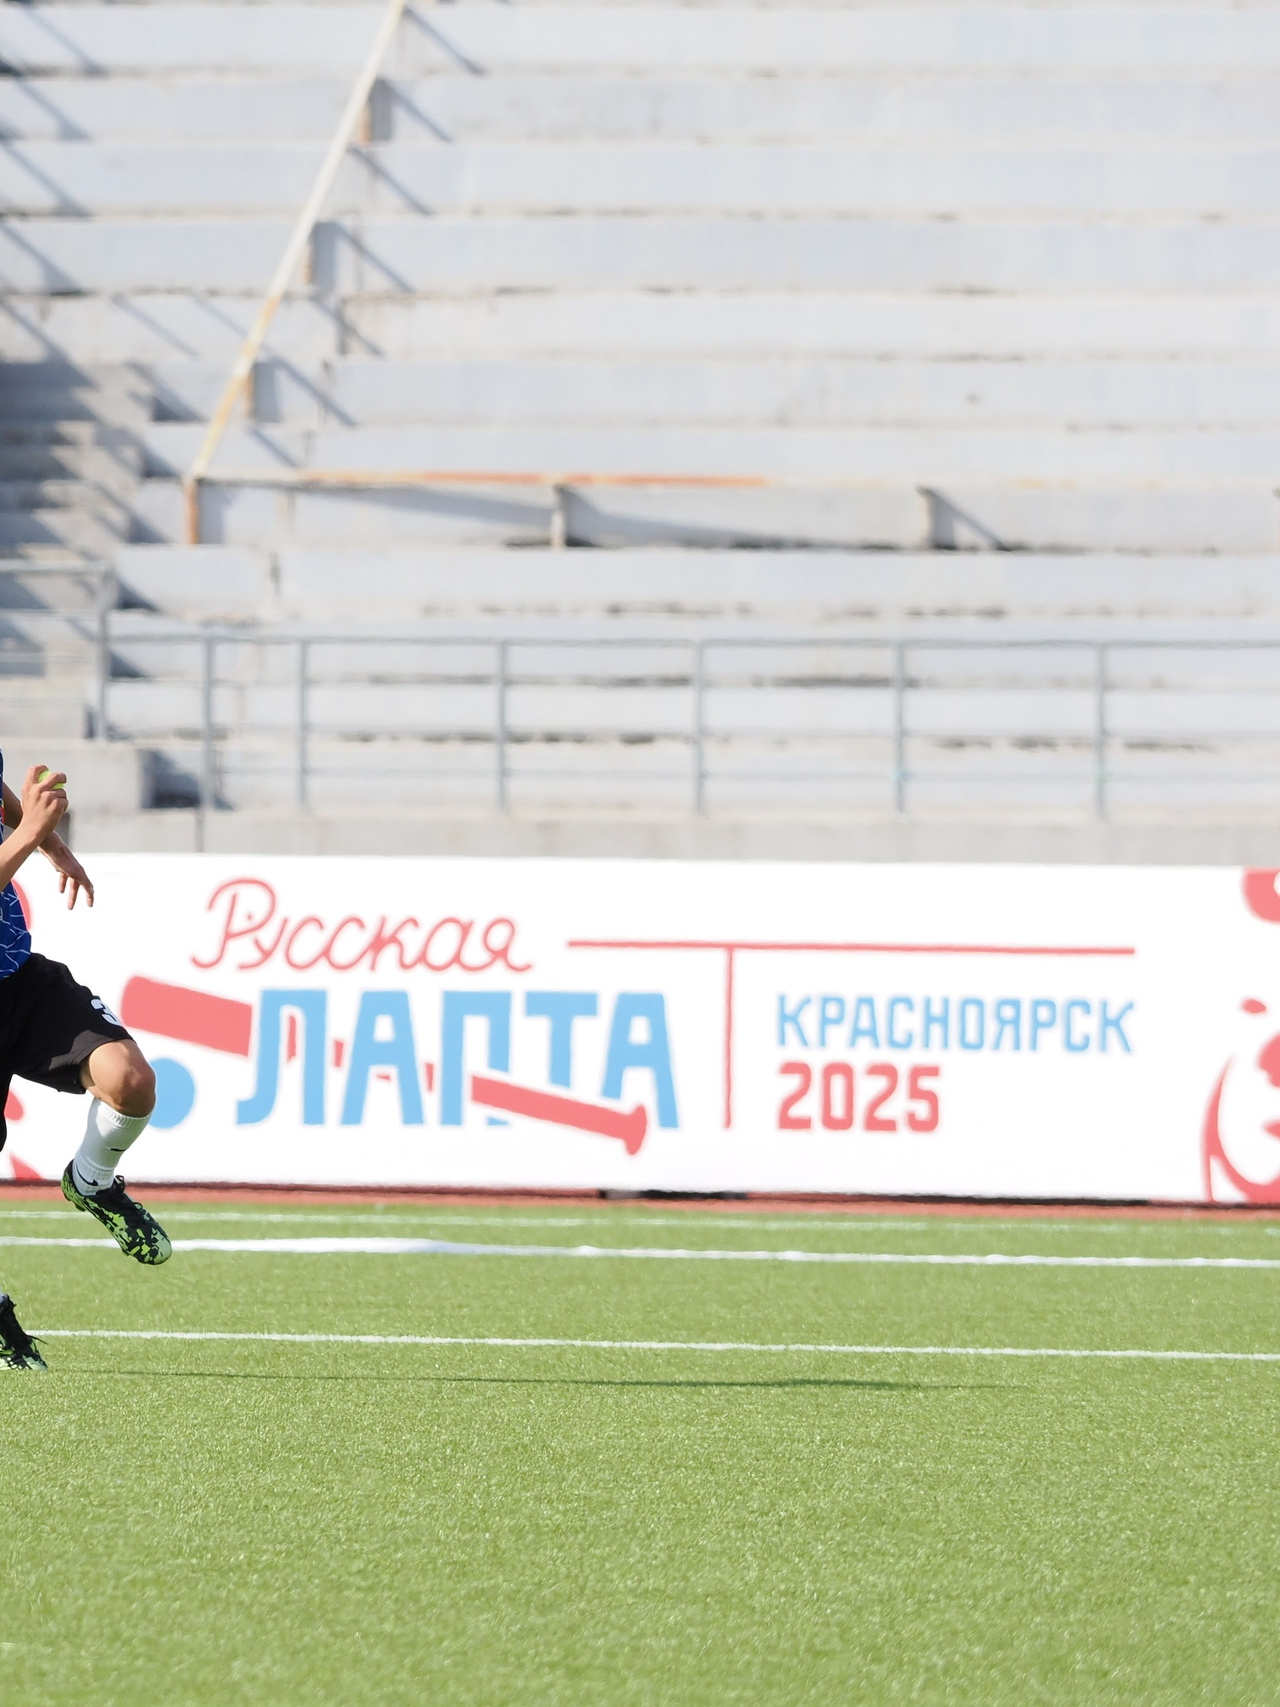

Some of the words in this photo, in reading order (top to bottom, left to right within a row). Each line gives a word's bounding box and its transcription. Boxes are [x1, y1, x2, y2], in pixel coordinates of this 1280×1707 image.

[191, 877, 535, 973] Русская
[236, 988, 680, 1130] ЛАПТА
[776, 994, 1135, 1054] КРАСНОЯРСК
[777, 1061, 942, 1133] 2025
